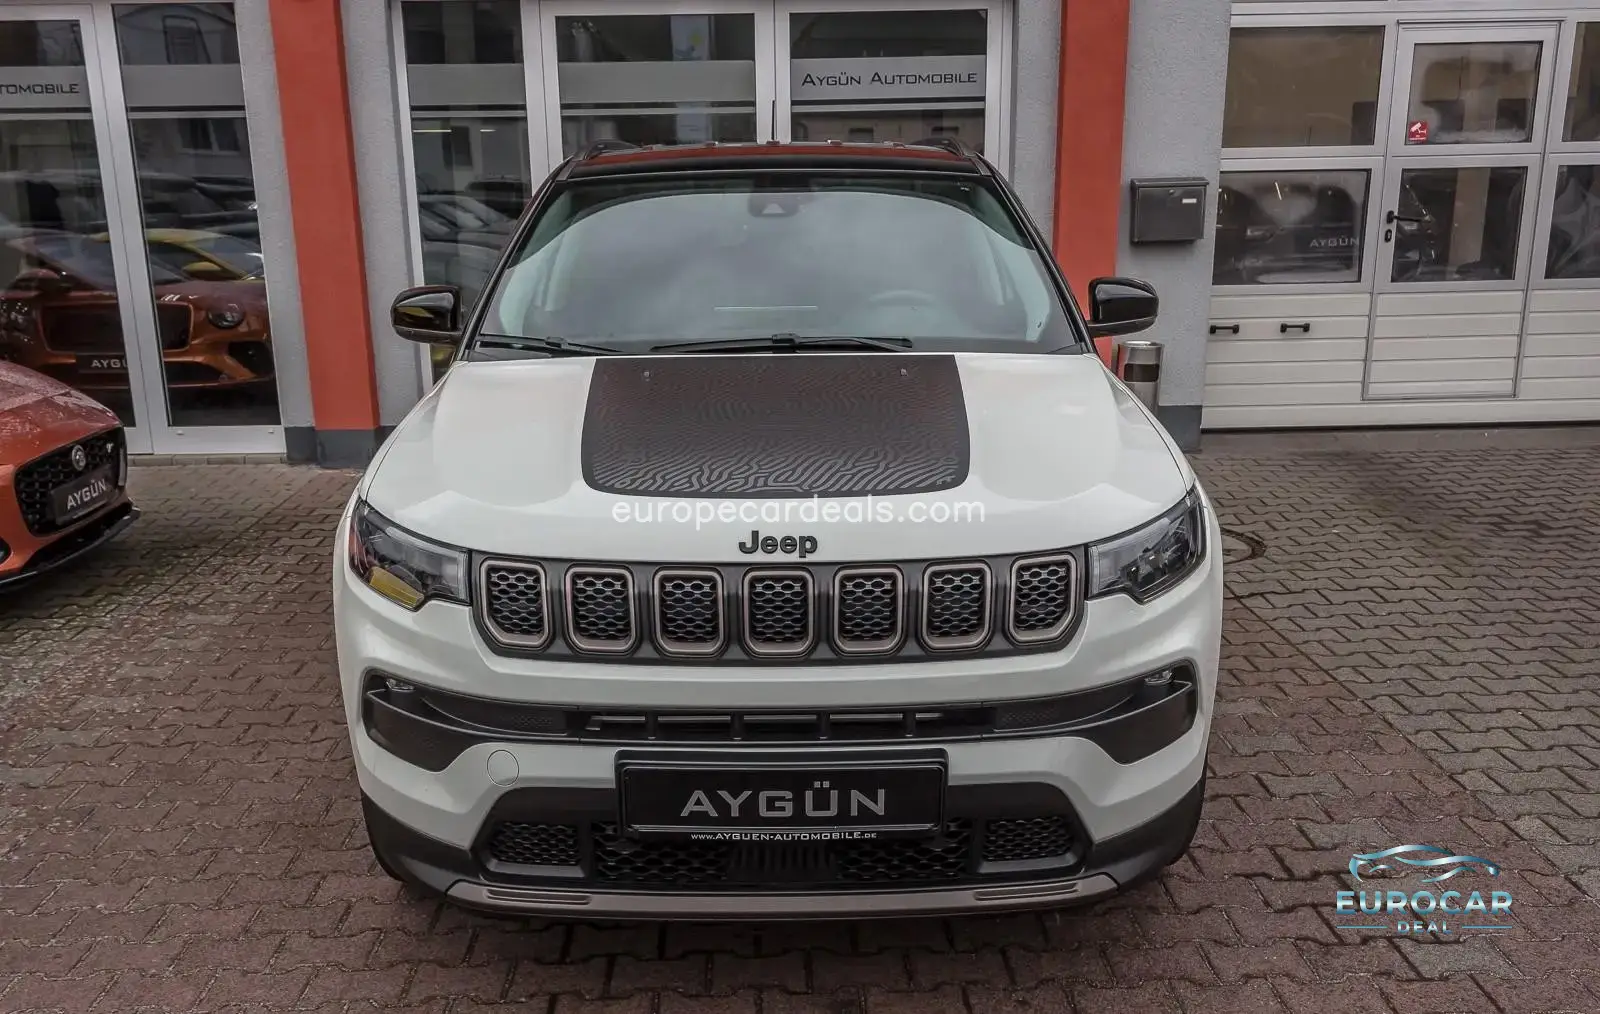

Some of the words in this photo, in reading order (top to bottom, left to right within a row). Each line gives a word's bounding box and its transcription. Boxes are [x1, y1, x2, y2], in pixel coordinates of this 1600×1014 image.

[801, 72, 862, 86] AYGÜN
[870, 72, 978, 85] AUTOMOBILE
[66, 478, 107, 510] AYGÜN
[738, 530, 818, 558] Jeep
[680, 781, 886, 817] AYGÜN
